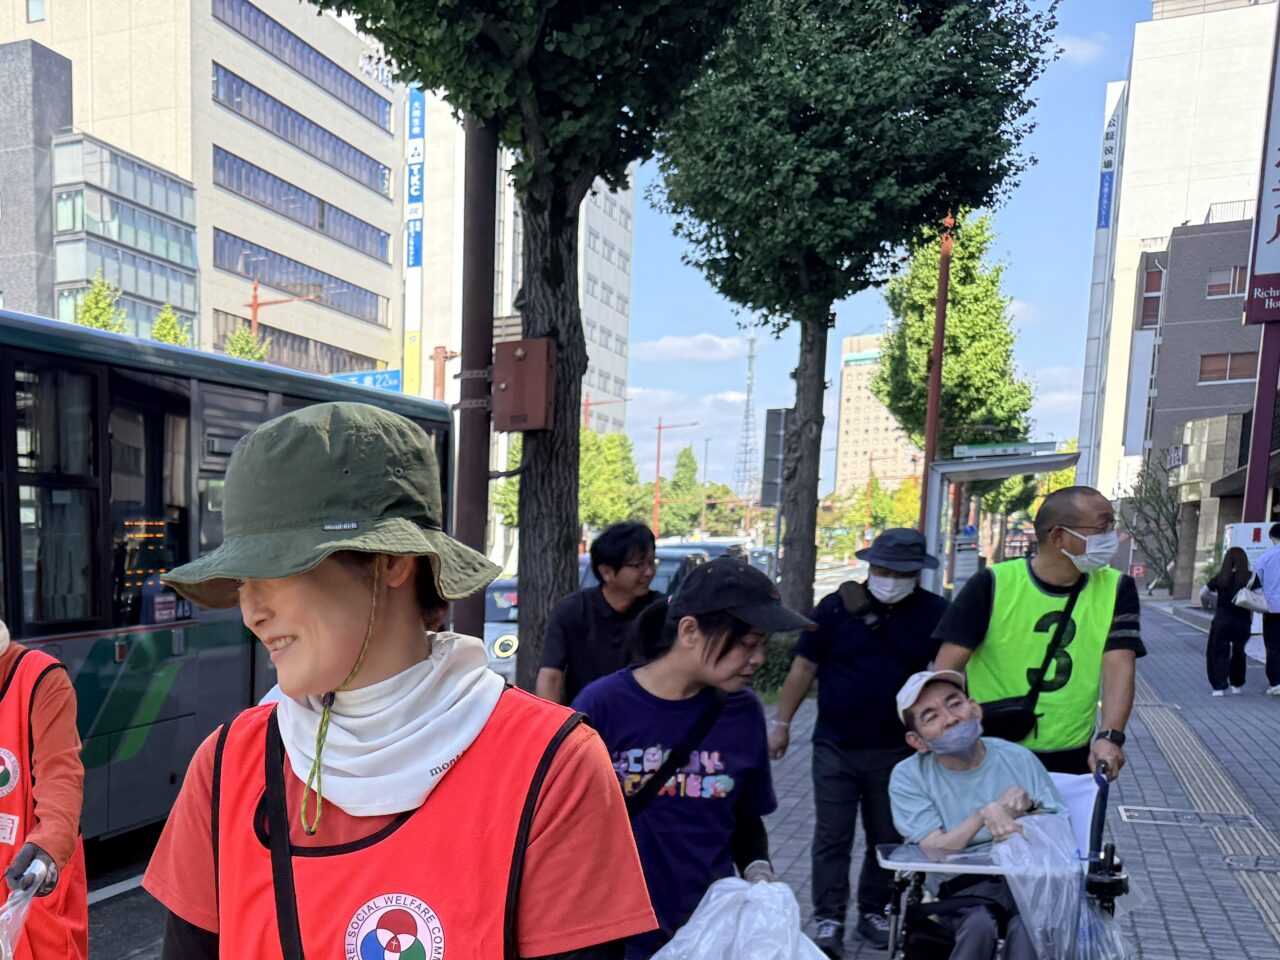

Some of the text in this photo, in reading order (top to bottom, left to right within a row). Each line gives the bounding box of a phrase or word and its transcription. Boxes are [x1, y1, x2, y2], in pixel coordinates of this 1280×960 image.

[410, 164, 421, 196] TKC
[1026, 610, 1077, 693] 3
[347, 901, 381, 938] SOCIAL
[383, 895, 437, 924] WELFARE
